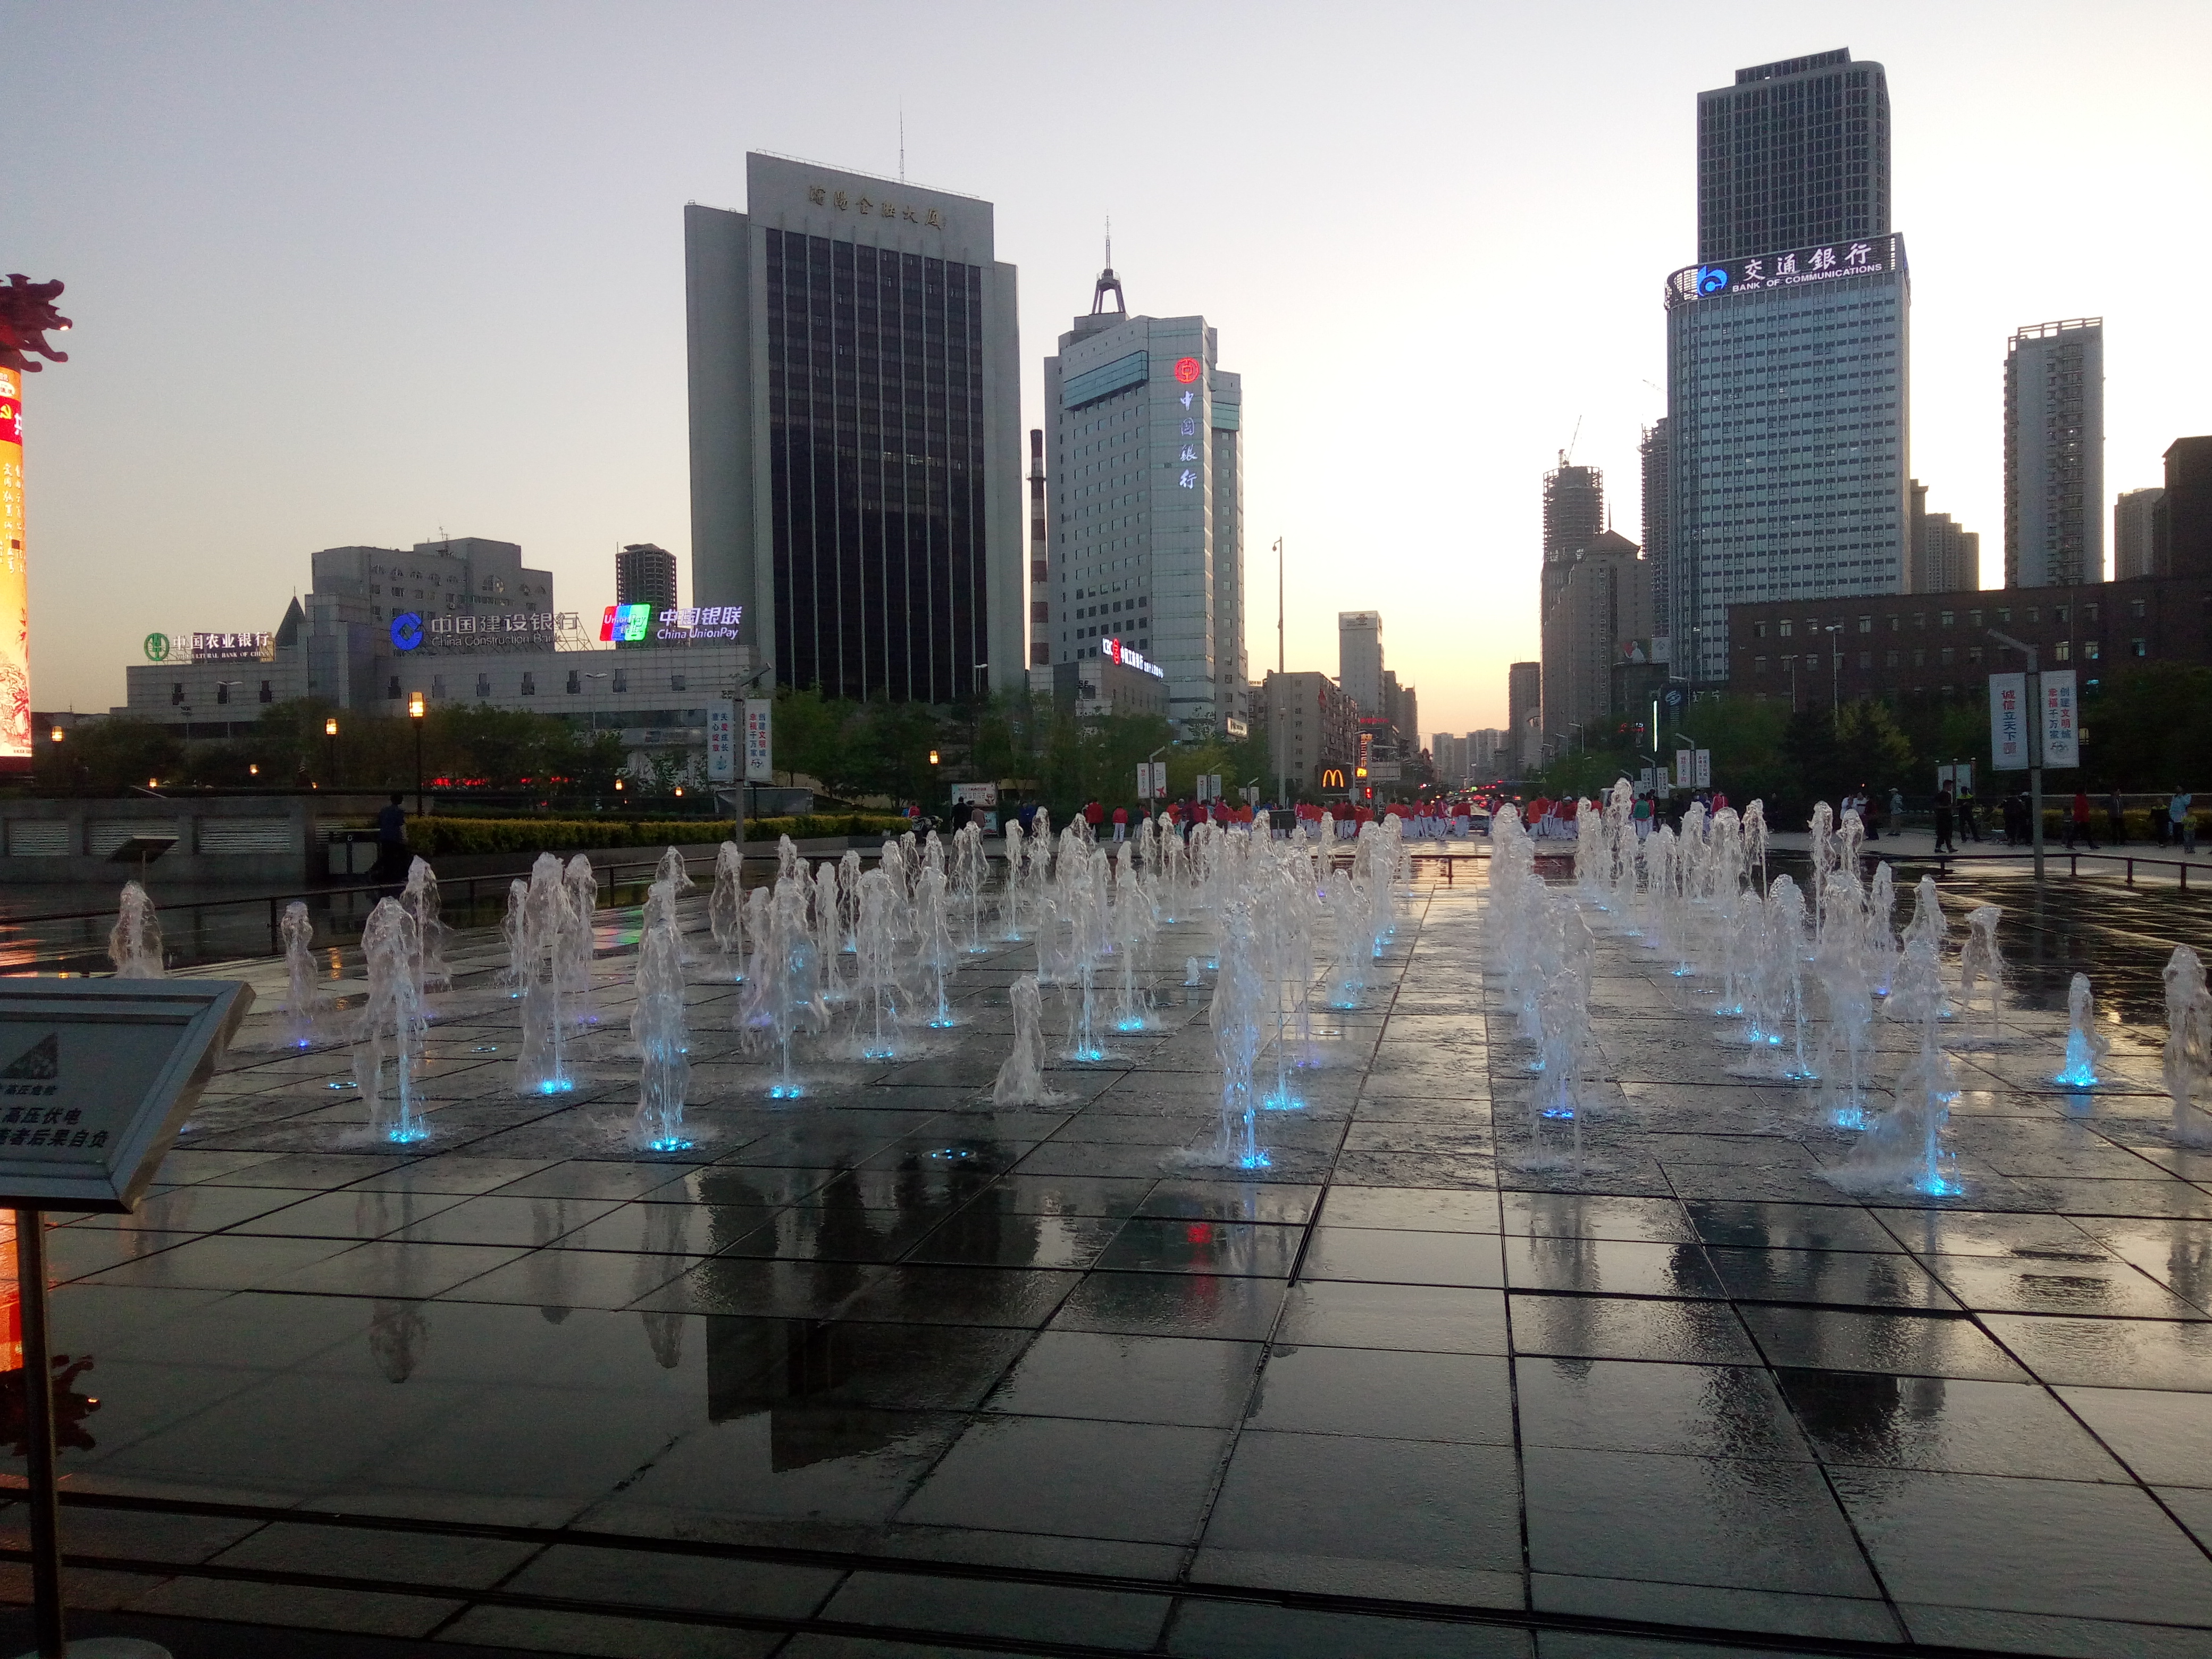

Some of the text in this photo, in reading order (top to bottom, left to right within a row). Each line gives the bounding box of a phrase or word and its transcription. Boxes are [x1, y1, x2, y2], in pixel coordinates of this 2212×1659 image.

[1742, 242, 1872, 282] 交通銀行
[1732, 263, 1883, 292] BANK OF COMMUNICATIONS
[431, 611, 579, 634] 中国建设银行
[659, 606, 743, 626] 中国银联
[173, 632, 269, 651] 中国农业银行
[432, 637, 462, 647] China
[464, 633, 530, 647] Construction
[657, 627, 739, 640] China UnionPay
